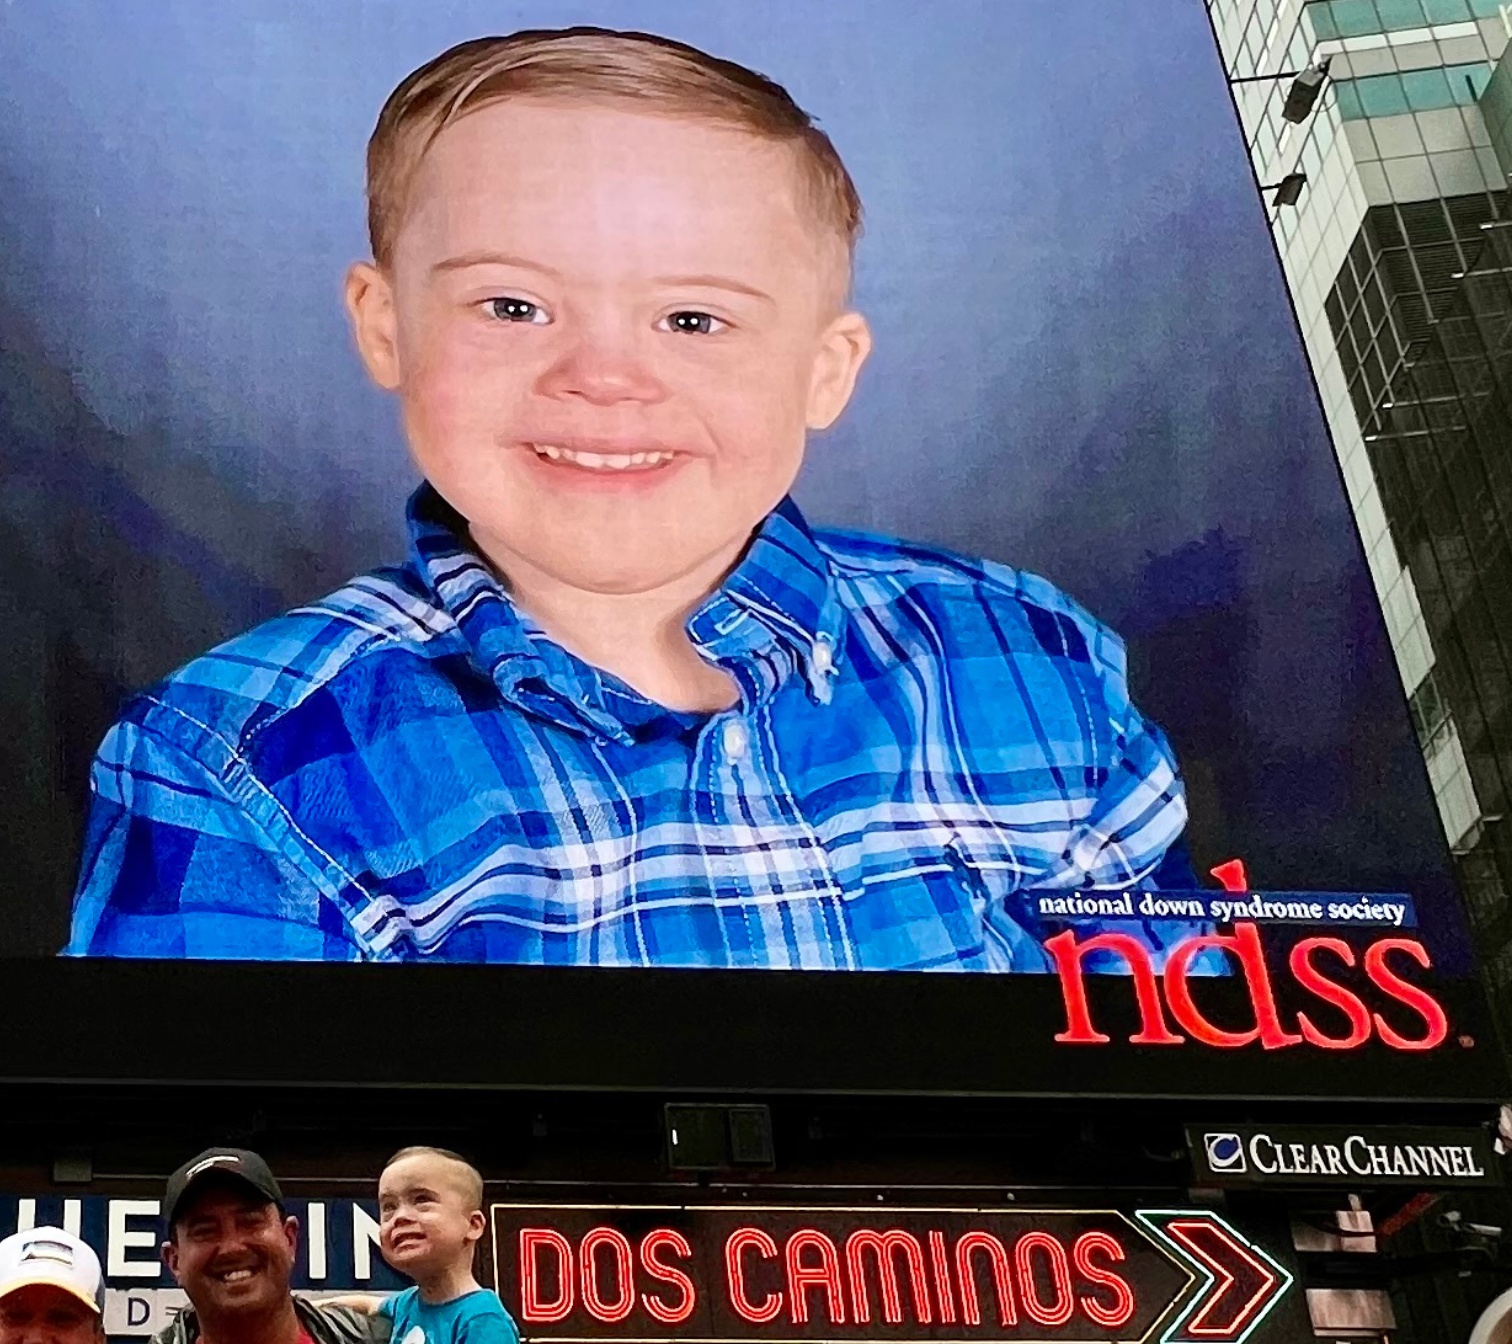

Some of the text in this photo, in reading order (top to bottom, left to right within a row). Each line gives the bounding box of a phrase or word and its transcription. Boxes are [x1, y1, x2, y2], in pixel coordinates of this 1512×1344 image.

[1039, 892, 1405, 926] national down syndrome society
[519, 1227, 1136, 1326] DOS CAMINOS
